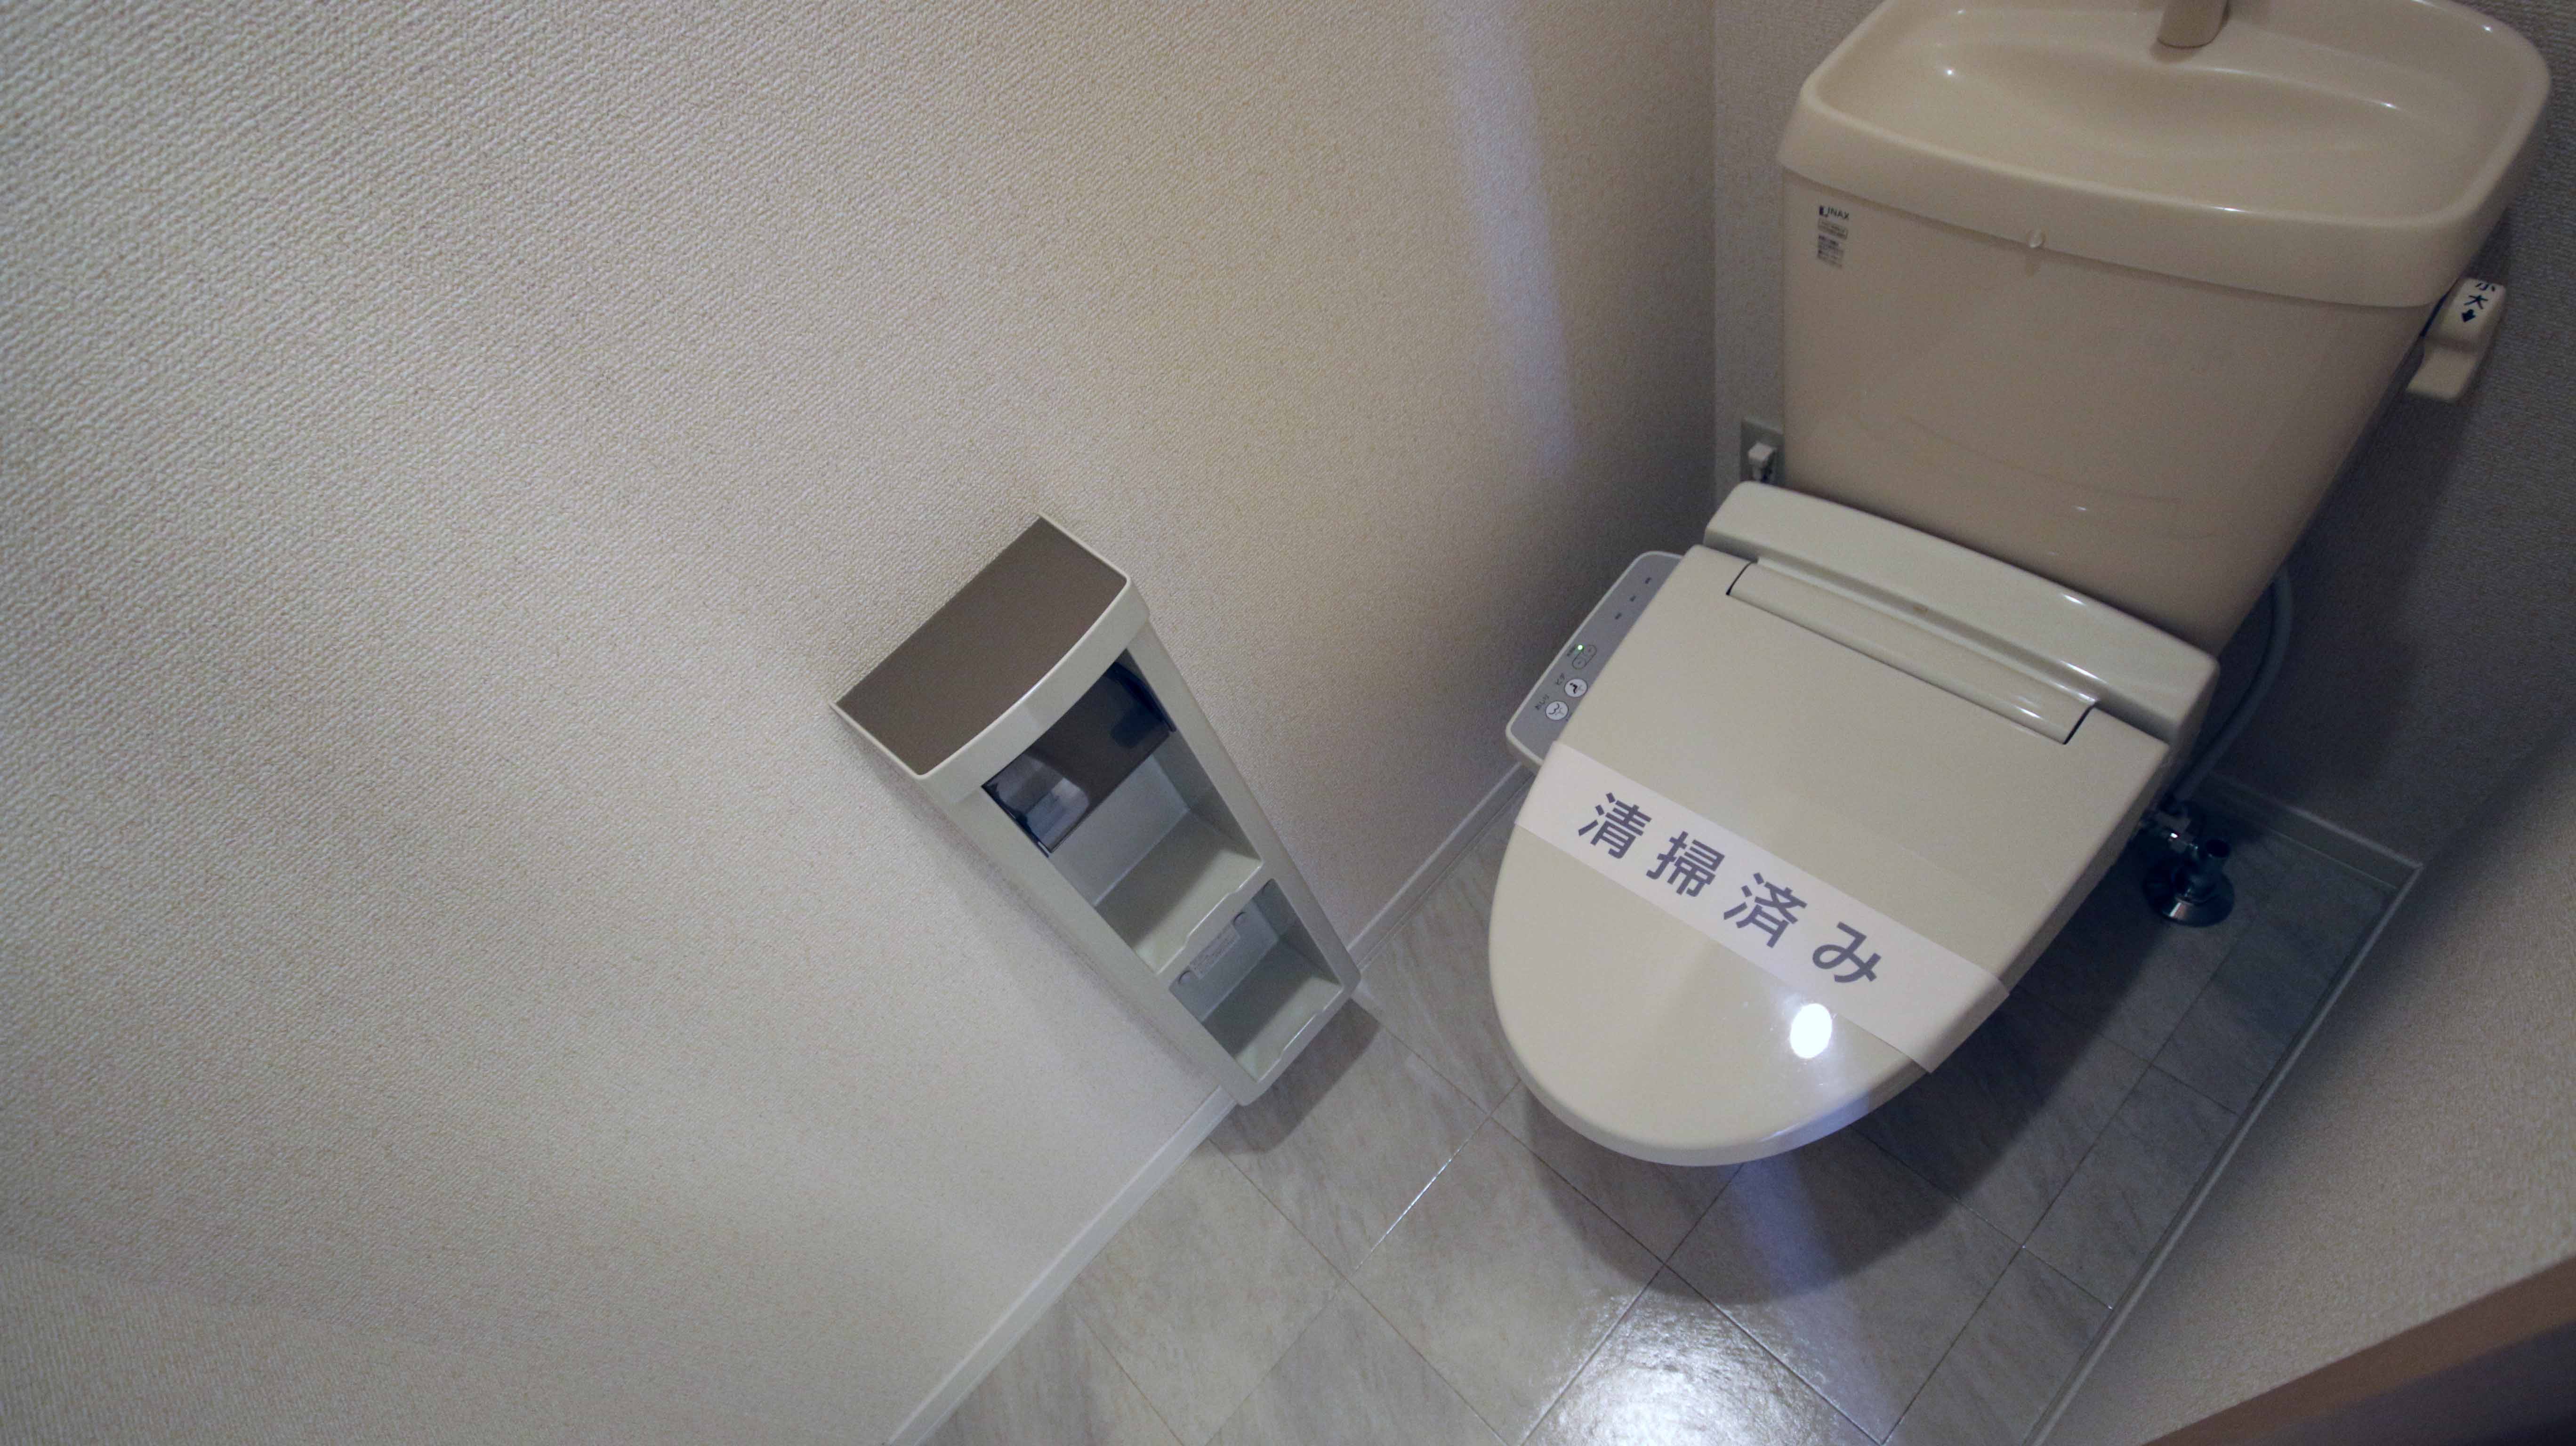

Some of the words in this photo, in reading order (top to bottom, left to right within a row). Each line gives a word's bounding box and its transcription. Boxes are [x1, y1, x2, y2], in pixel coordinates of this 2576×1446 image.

[2463, 295, 2489, 309] 大
[1578, 792, 1882, 983] 清掃済み
